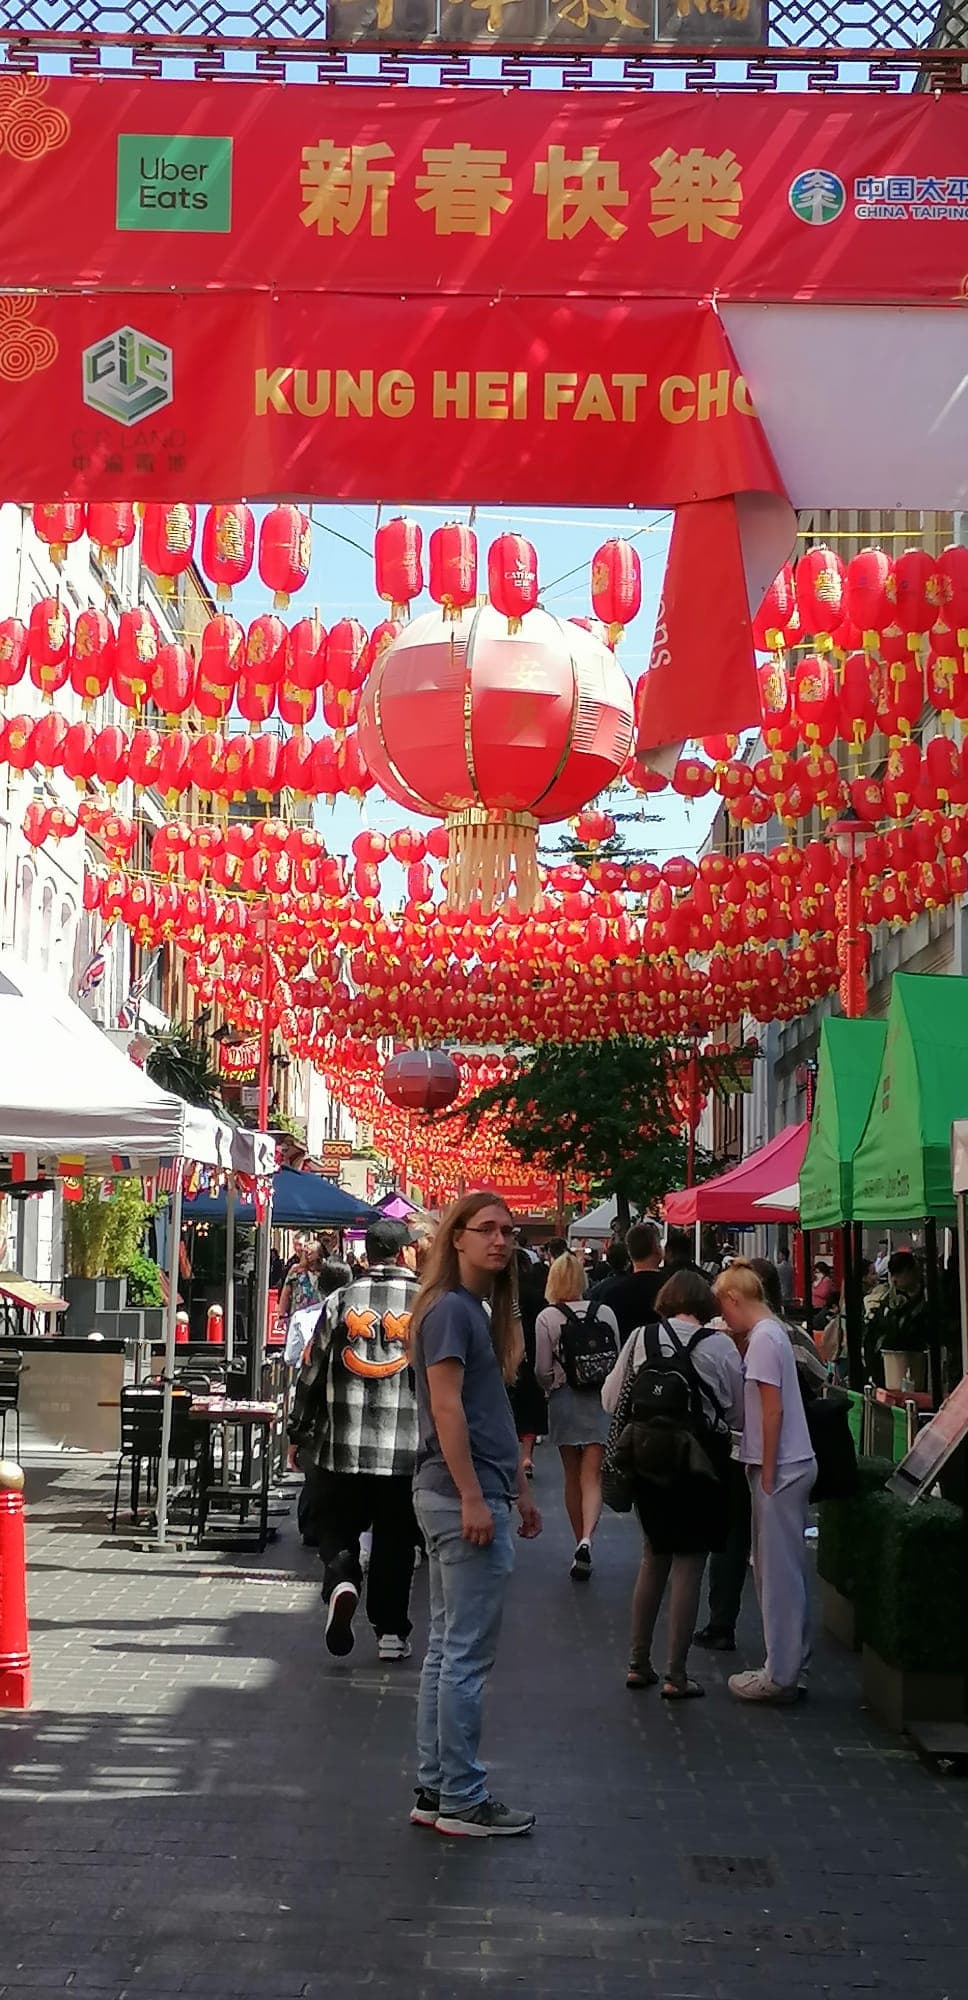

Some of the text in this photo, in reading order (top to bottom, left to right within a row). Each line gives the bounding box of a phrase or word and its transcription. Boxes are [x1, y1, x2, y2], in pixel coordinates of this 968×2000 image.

[139, 156, 209, 182] Uber
[138, 185, 209, 210] Eats
[300, 139, 743, 242] 新春快樂
[856, 178, 968, 201] 中国太平
[857, 206, 968, 218] CHINA TAIPIN
[254, 367, 415, 418] KUNG
[433, 370, 528, 420] HEI
[544, 372, 648, 421] FAT
